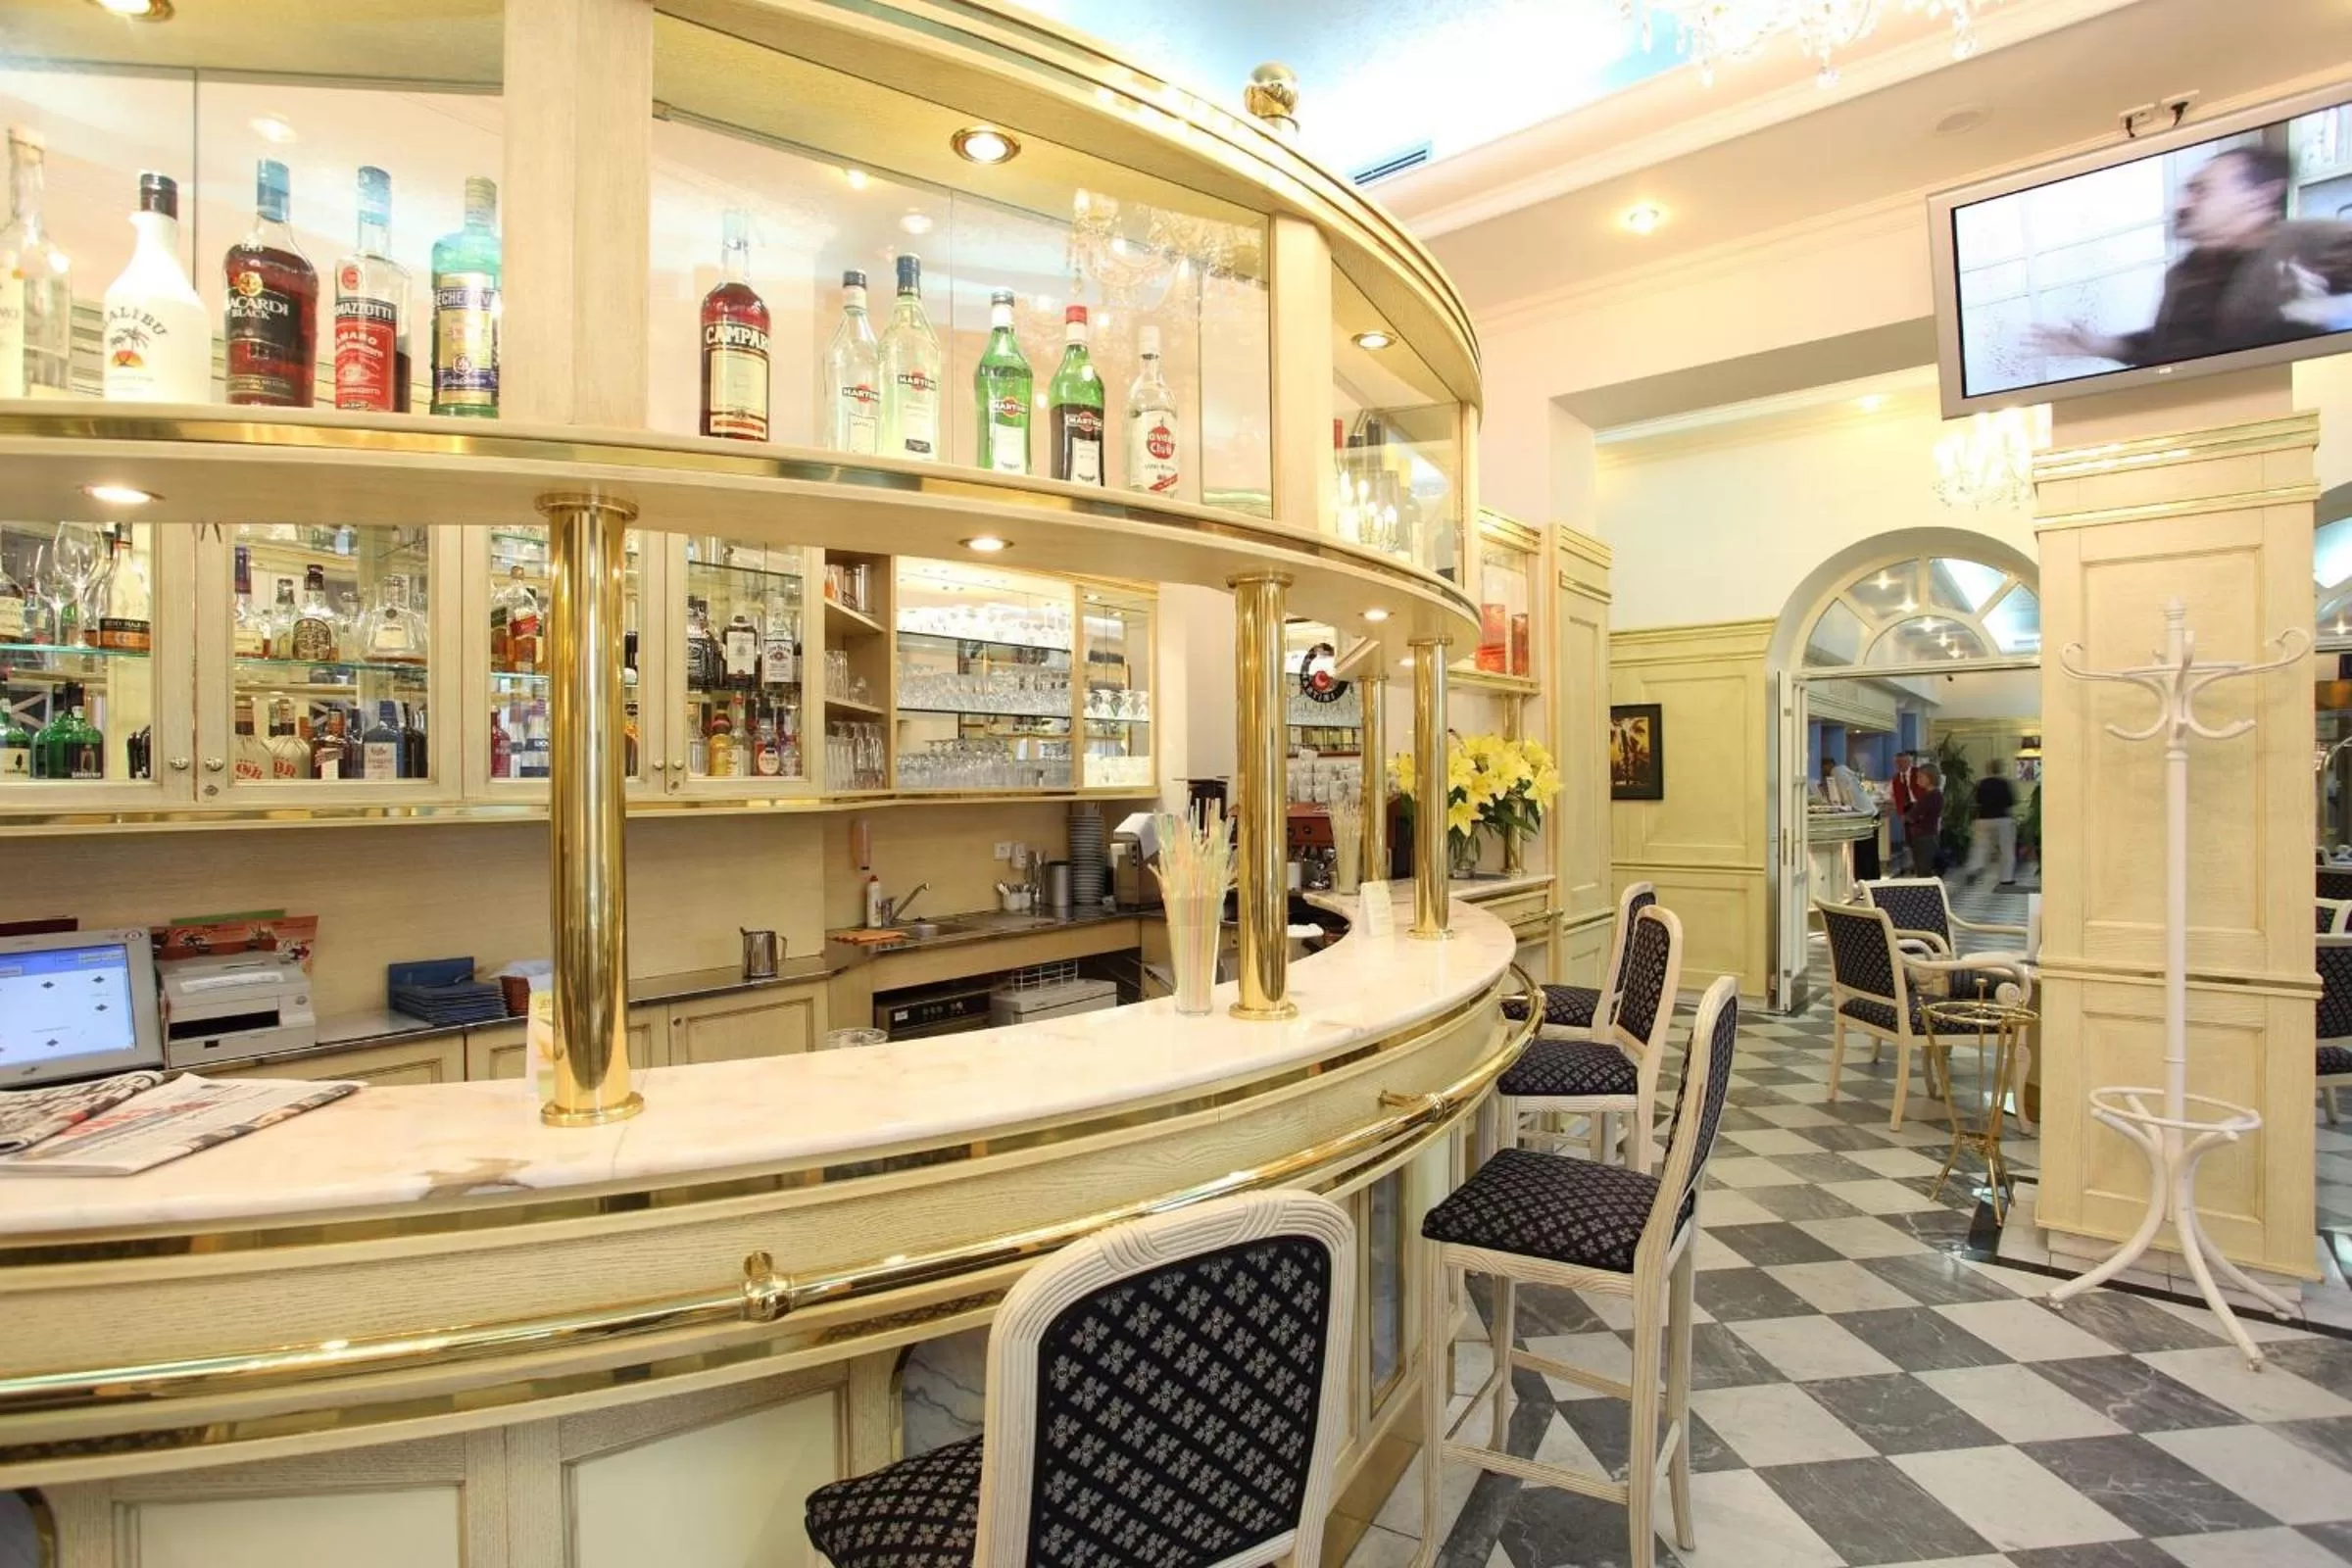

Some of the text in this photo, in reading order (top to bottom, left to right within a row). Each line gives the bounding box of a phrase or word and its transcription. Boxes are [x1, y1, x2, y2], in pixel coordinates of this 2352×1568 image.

[231, 308, 270, 320] BLACK
[335, 302, 392, 319] MAZZOTTI
[706, 324, 771, 352] CAMPAR
